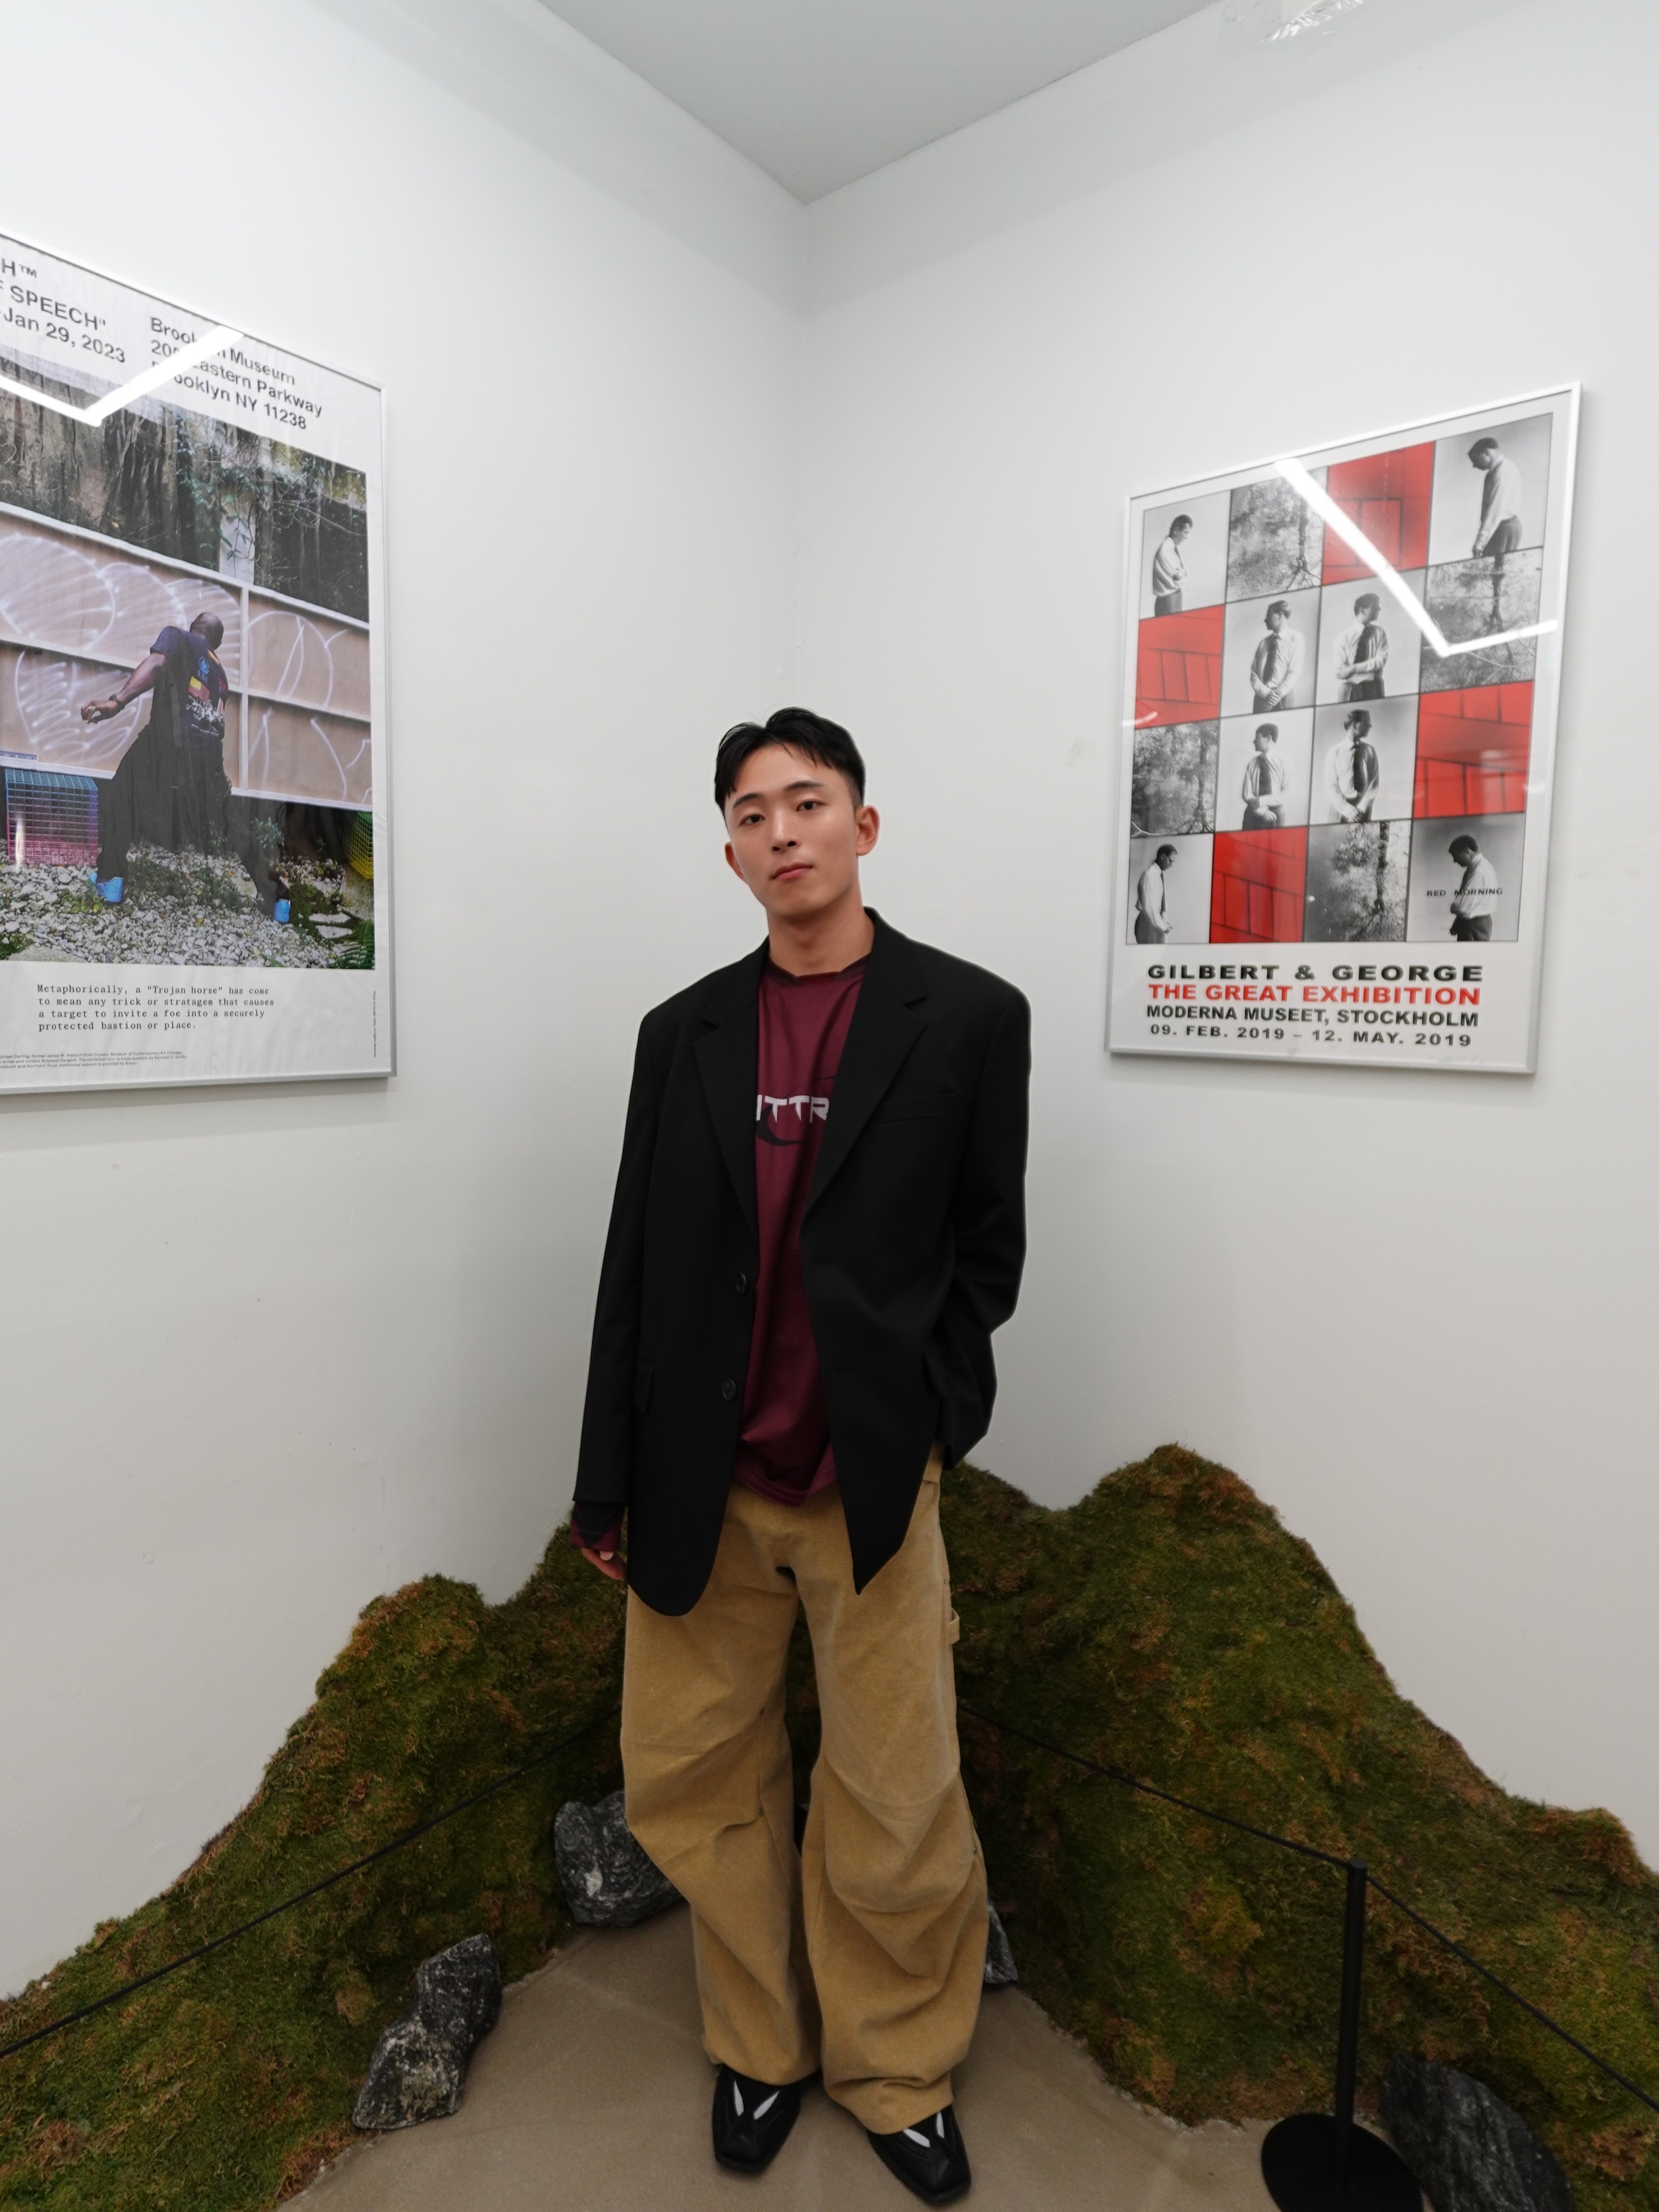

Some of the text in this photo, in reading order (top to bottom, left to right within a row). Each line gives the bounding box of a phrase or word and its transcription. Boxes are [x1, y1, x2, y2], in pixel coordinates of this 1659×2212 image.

[10, 285, 106, 331] SPEECH"
[3, 307, 126, 363] Jan 29, 2023
[230, 347, 295, 386] Museum
[191, 358, 251, 389] astern
[257, 379, 322, 417] Parkway
[236, 392, 258, 412] NY
[264, 403, 307, 430] 11238
[1454, 887, 1503, 896] MORNING
[1148, 964, 1483, 982] GILBERT & GEORGE
[37, 984, 127, 994] Metaphorically,
[1148, 983, 1481, 1006] THE GREAT EXHIBITION
[51, 1010, 87, 1019] target
[113, 1009, 147, 1017] invite
[224, 1009, 265, 1019] securely
[88, 999, 106, 1007] any
[164, 999, 213, 1007] stratagem
[38, 1022, 95, 1032] protected
[101, 1022, 142, 1030] bastion
[1147, 1004, 1479, 1027] MODERNA MUSEET, STOCKHOLM
[1150, 1024, 1177, 1035] 09.
[1186, 1025, 1228, 1037] FEB.
[1237, 1027, 1285, 1039] 2019
[1312, 1029, 1343, 1042] 12.
[1353, 1030, 1404, 1044] MAY.
[1415, 1032, 1472, 1047] 2019
